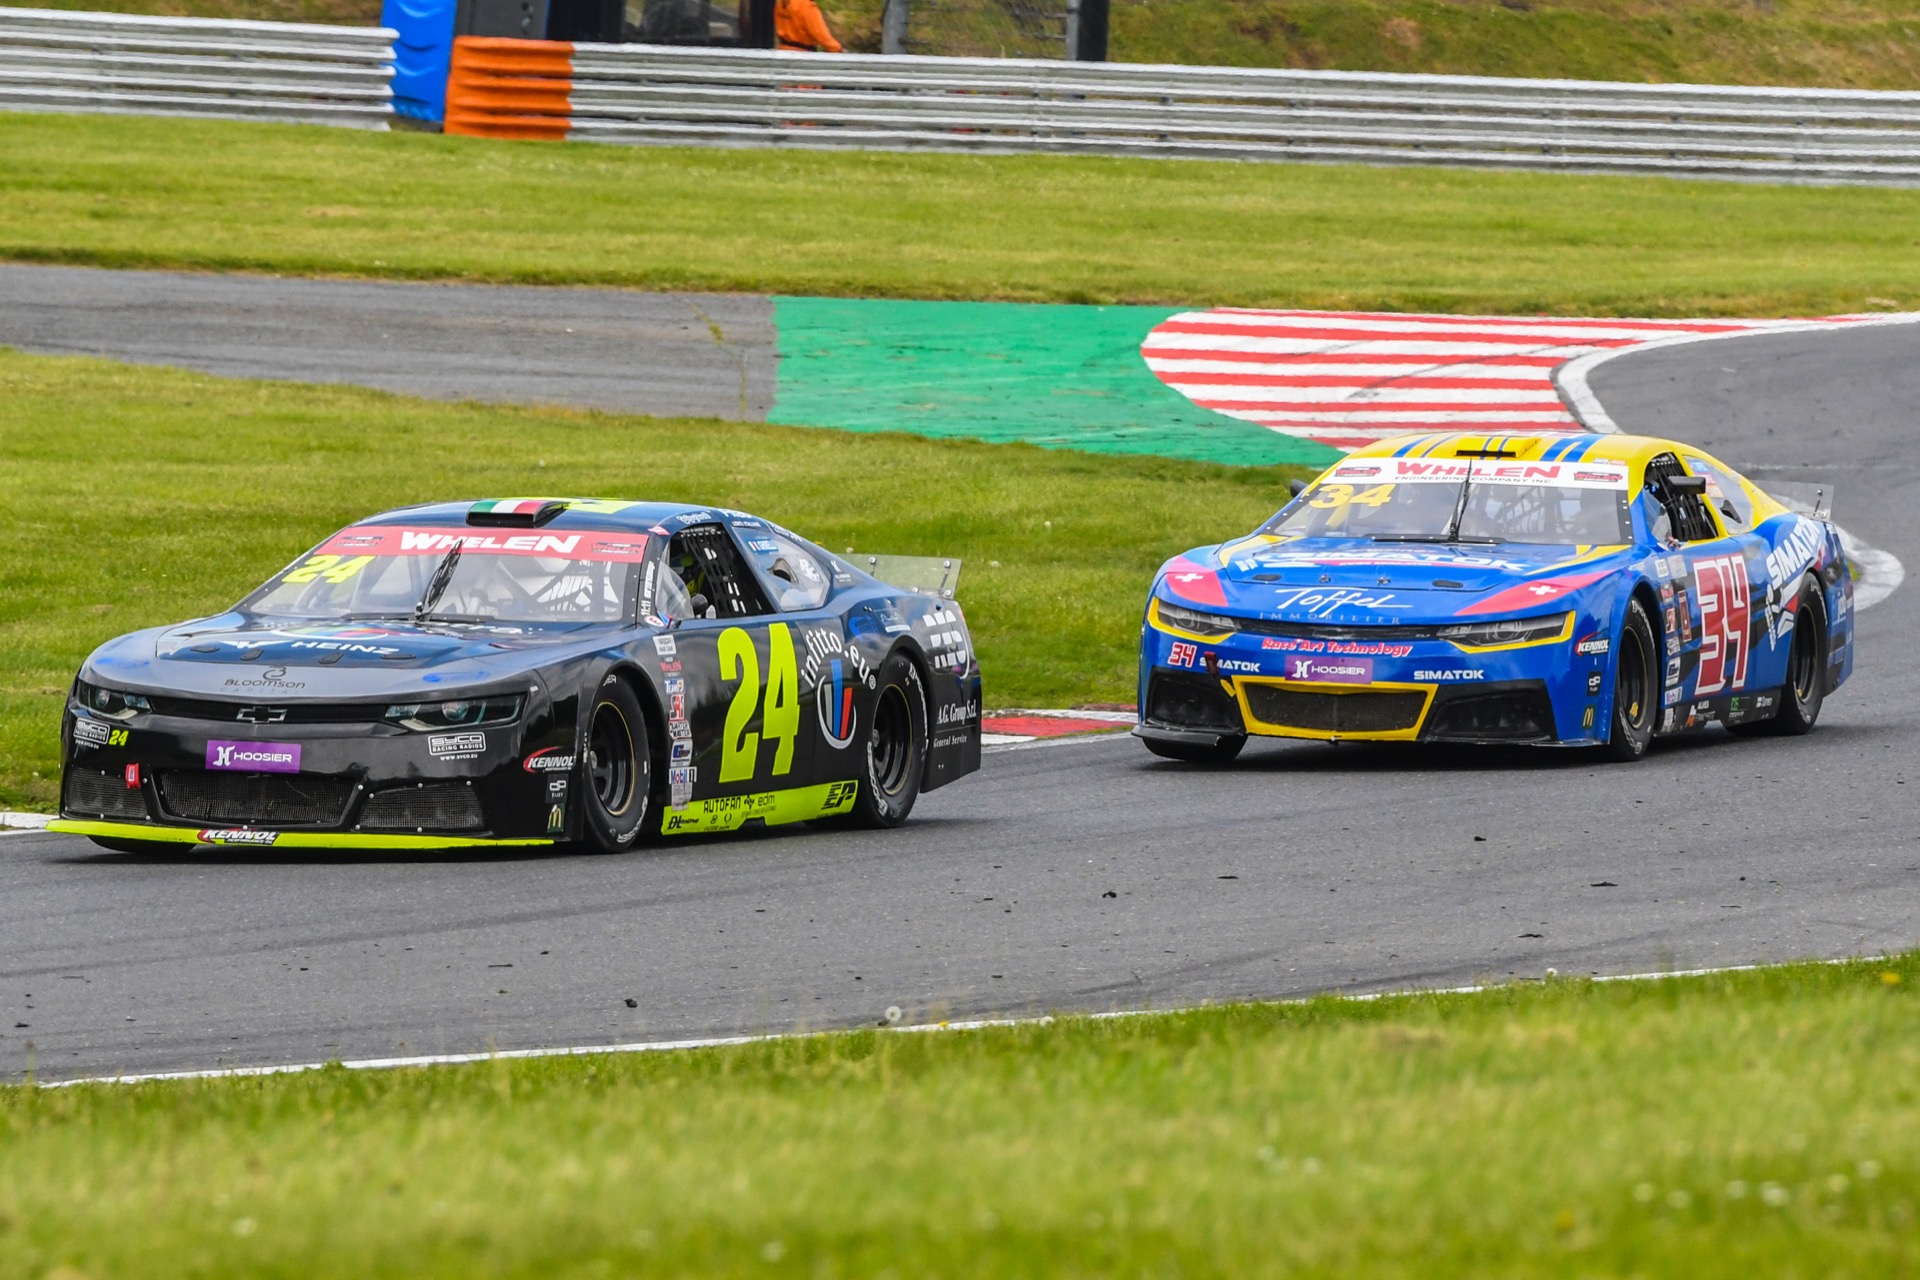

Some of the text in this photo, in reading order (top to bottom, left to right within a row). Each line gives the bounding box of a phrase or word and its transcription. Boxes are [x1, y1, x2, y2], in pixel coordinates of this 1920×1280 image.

[1397, 462, 1561, 479] WHELEN
[1309, 484, 1396, 508] 34
[401, 532, 581, 553] WHELEN
[281, 555, 376, 583] 24
[1260, 612, 1400, 624] IMMOBILIER
[1692, 554, 1750, 698] 34
[291, 641, 399, 654] HEINZ
[1261, 638, 1413, 658] Race Art Technology
[1577, 639, 1609, 652] KENNOL
[1168, 642, 1197, 667] 34
[1199, 656, 1261, 673] SMATOK
[1312, 665, 1365, 676] HOOSIER
[1413, 669, 1484, 680] SIMATOK
[717, 622, 800, 784] 24
[950, 703, 966, 725] Group
[108, 730, 129, 746] 24
[431, 735, 482, 744] SYCO
[933, 734, 968, 748] General Service
[234, 752, 292, 762] HOOSIER
[528, 756, 574, 768] KENNOL
[671, 768, 688, 784] Mobil
[704, 796, 741, 814] AUTOFAN
[202, 830, 277, 840] KENNOL
